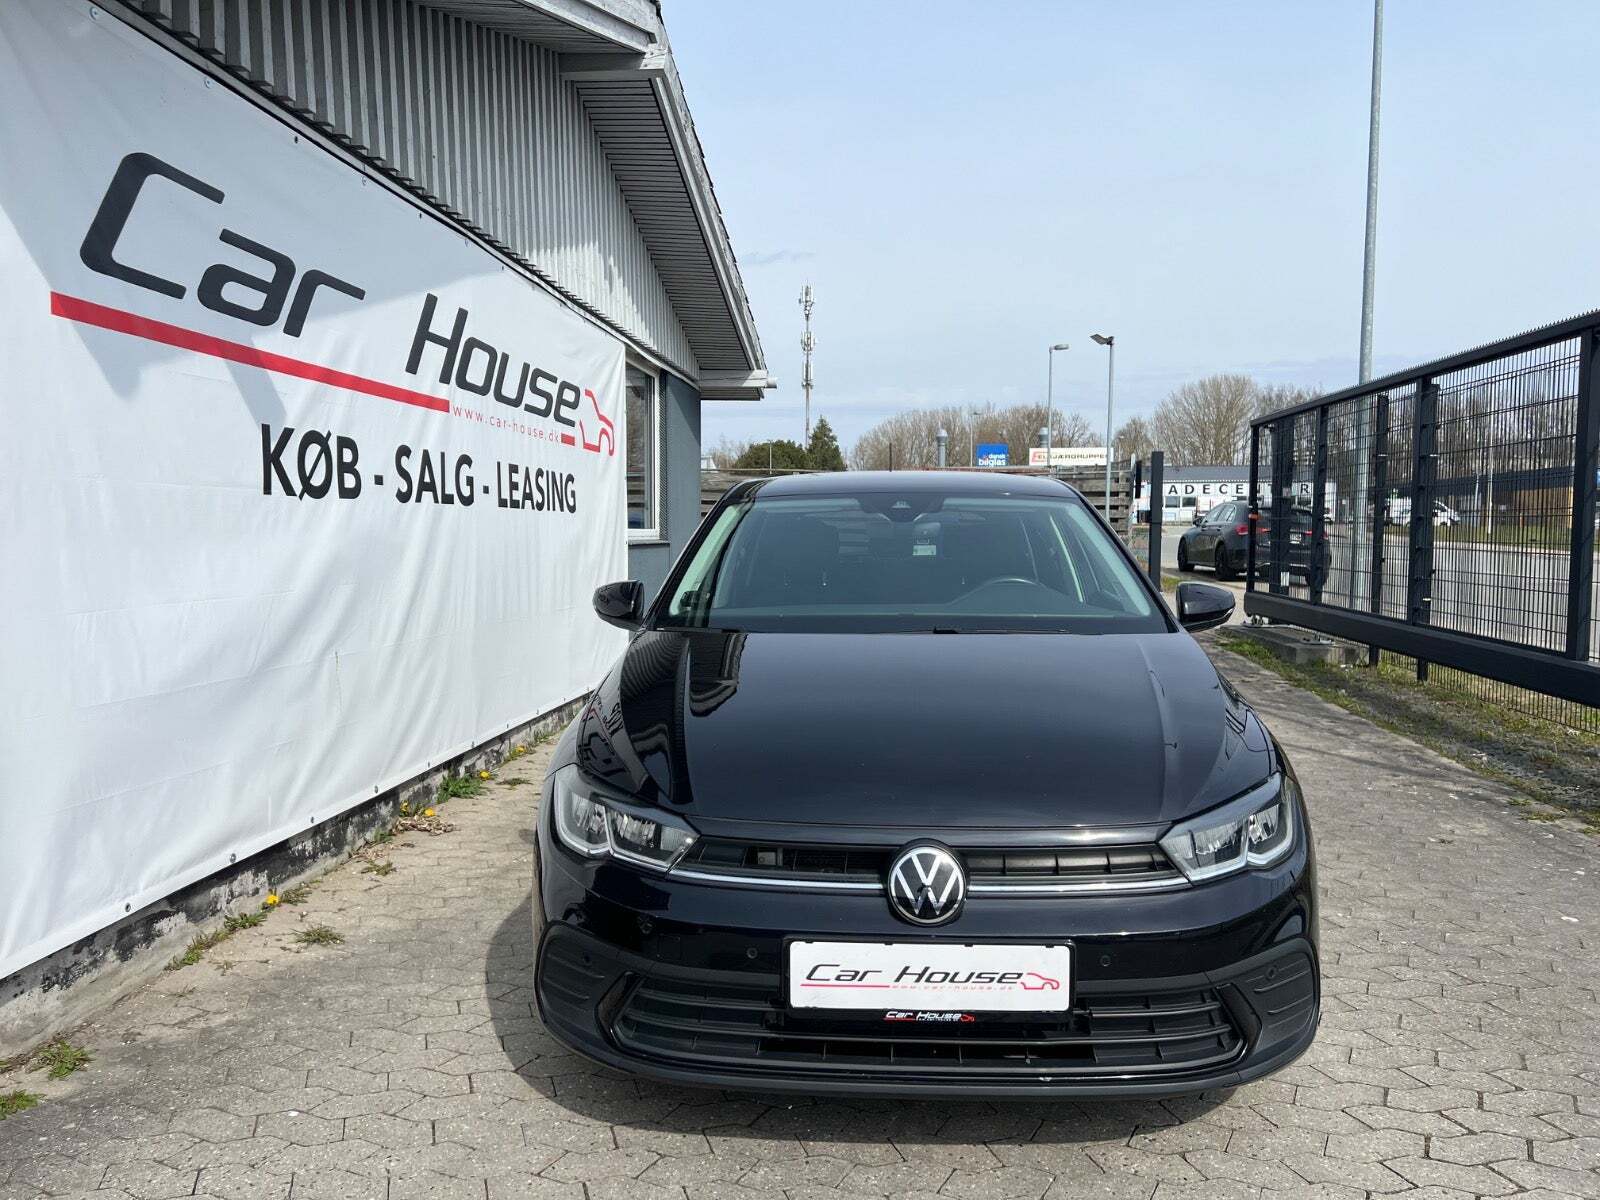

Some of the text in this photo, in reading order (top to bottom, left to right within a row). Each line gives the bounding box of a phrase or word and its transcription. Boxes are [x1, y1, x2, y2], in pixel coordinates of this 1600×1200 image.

[80, 152, 581, 428] Car House
[452, 405, 560, 442] www.car-house.dk
[261, 423, 362, 502] KØB
[395, 444, 475, 506] SALG
[496, 461, 577, 514] LEASING
[978, 458, 1006, 467] bilglas
[806, 964, 1023, 984] Car House
[916, 1012, 961, 1020] House
